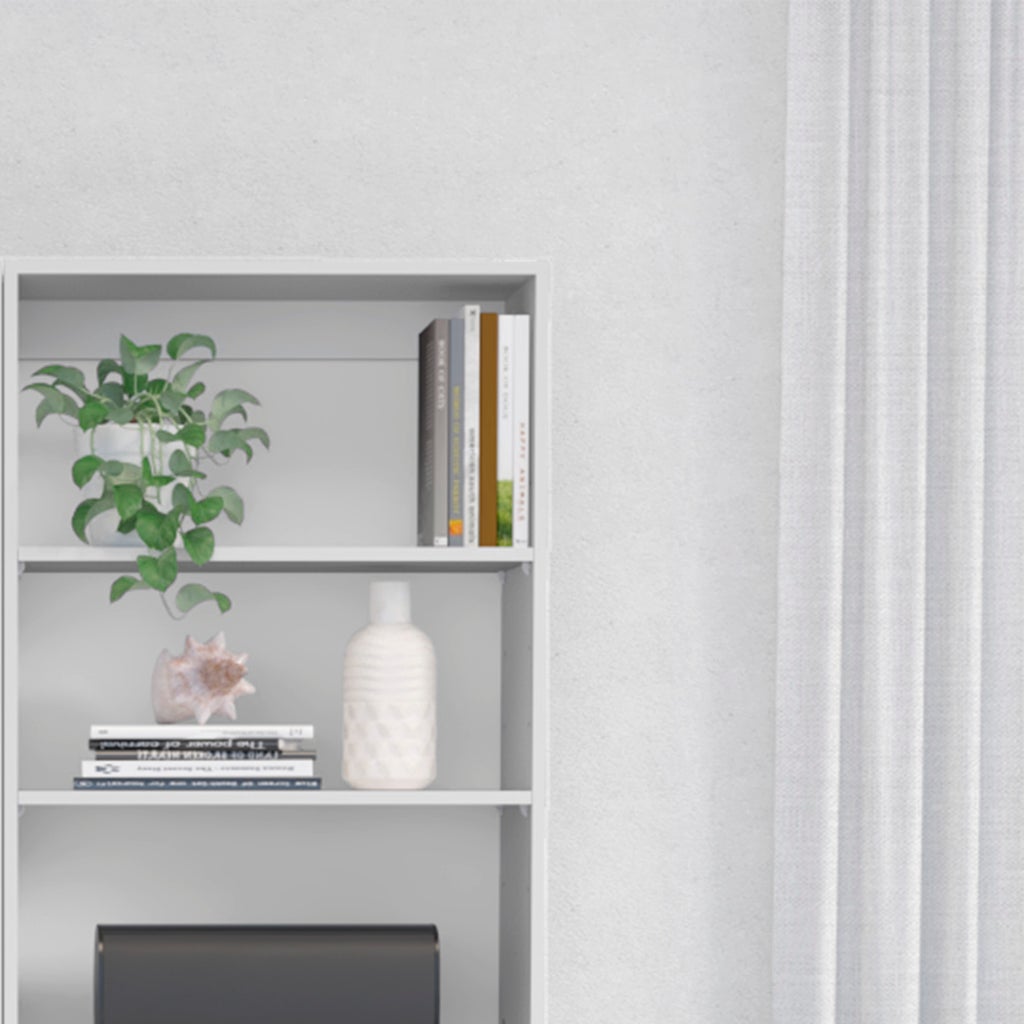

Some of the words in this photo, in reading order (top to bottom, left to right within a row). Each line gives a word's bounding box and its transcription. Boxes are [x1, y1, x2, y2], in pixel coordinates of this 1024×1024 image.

[437, 339, 447, 366] BOOK
[437, 385, 447, 410] CATS
[519, 421, 527, 459] HAPPY
[518, 468, 527, 522] ANIMALS
[99, 741, 161, 750] carnival
[164, 741, 181, 750] of
[187, 738, 233, 749] power
[237, 741, 264, 750] The
